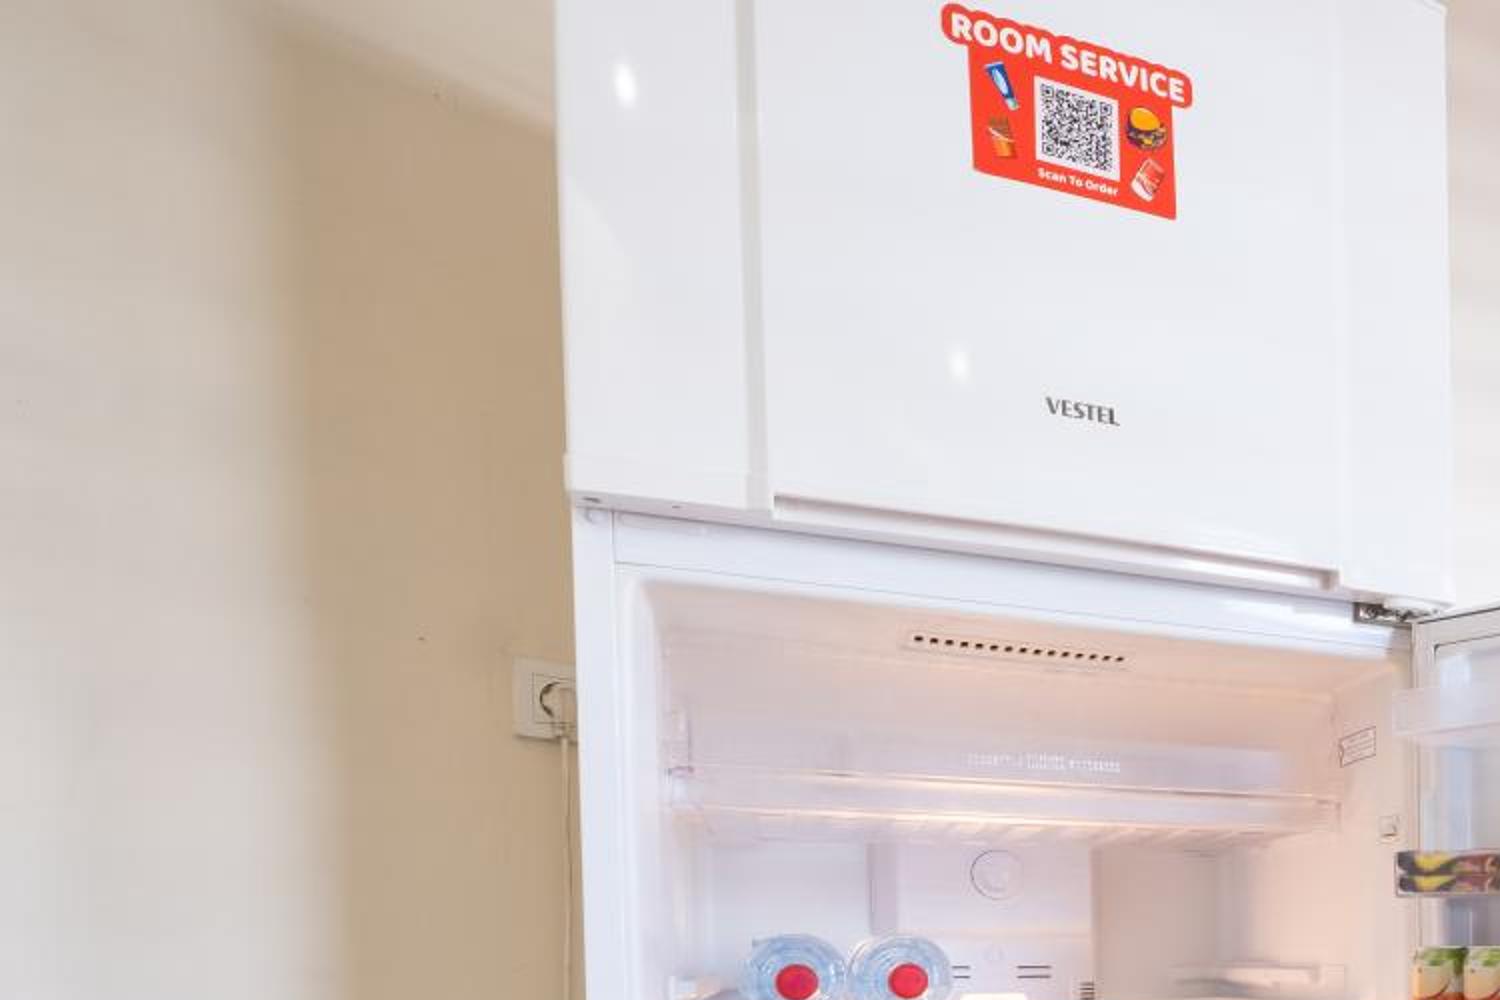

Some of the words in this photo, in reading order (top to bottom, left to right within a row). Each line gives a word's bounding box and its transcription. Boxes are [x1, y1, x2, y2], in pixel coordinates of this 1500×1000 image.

[951, 12, 1053, 65] ROOM
[1060, 44, 1186, 103] SERVICE
[1038, 167, 1067, 184] Scan
[1068, 175, 1083, 188] To
[1085, 179, 1120, 198] Order
[1045, 396, 1120, 426] VESTEL
